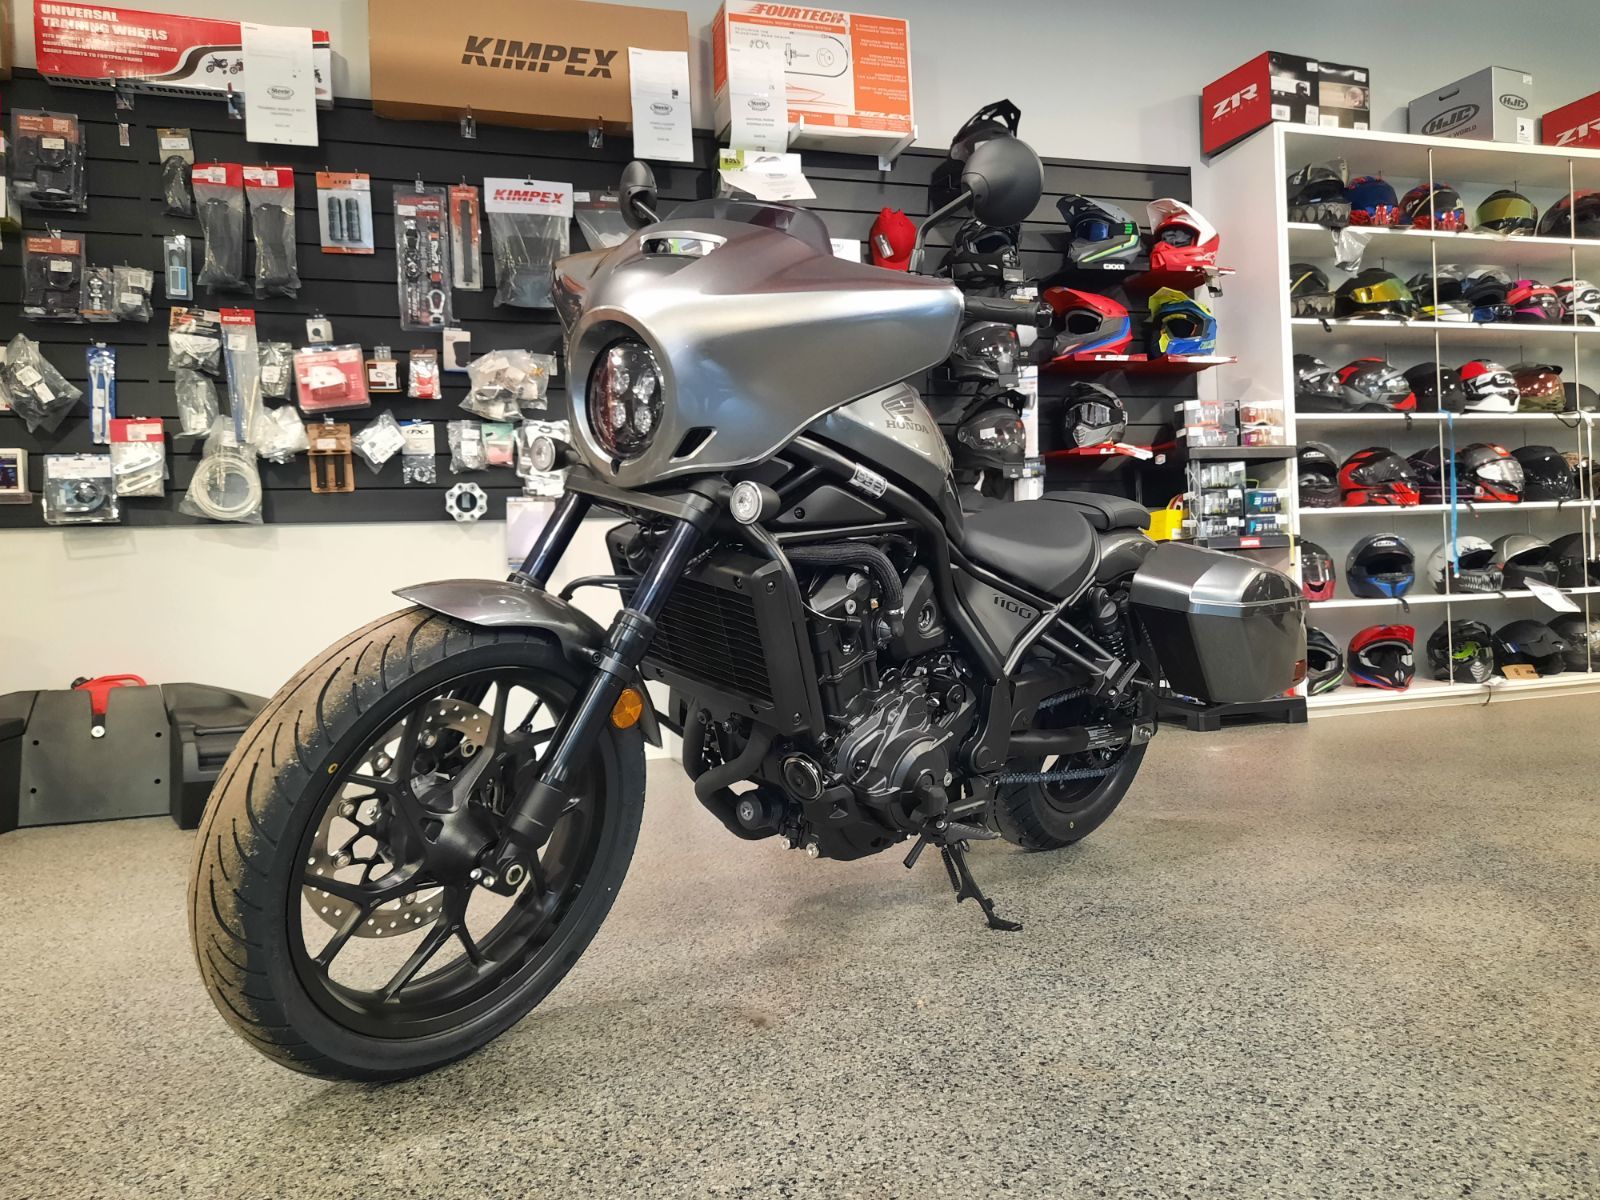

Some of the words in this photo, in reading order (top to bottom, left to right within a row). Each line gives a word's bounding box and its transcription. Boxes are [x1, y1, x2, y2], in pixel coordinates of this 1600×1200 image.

[41, 4, 119, 21] UNIVERSAL
[757, 4, 845, 23] FOURTECH
[42, 17, 109, 33] TRAINING
[112, 25, 168, 40] WHEELS
[461, 36, 617, 78] KIMPEX
[148, 87, 225, 98] TRAINING
[1428, 106, 1472, 133] HJC
[1453, 124, 1477, 137] WORLD
[493, 189, 564, 204] KIMPEX
[886, 419, 930, 433] HONDA
[992, 593, 1032, 619] 1100
